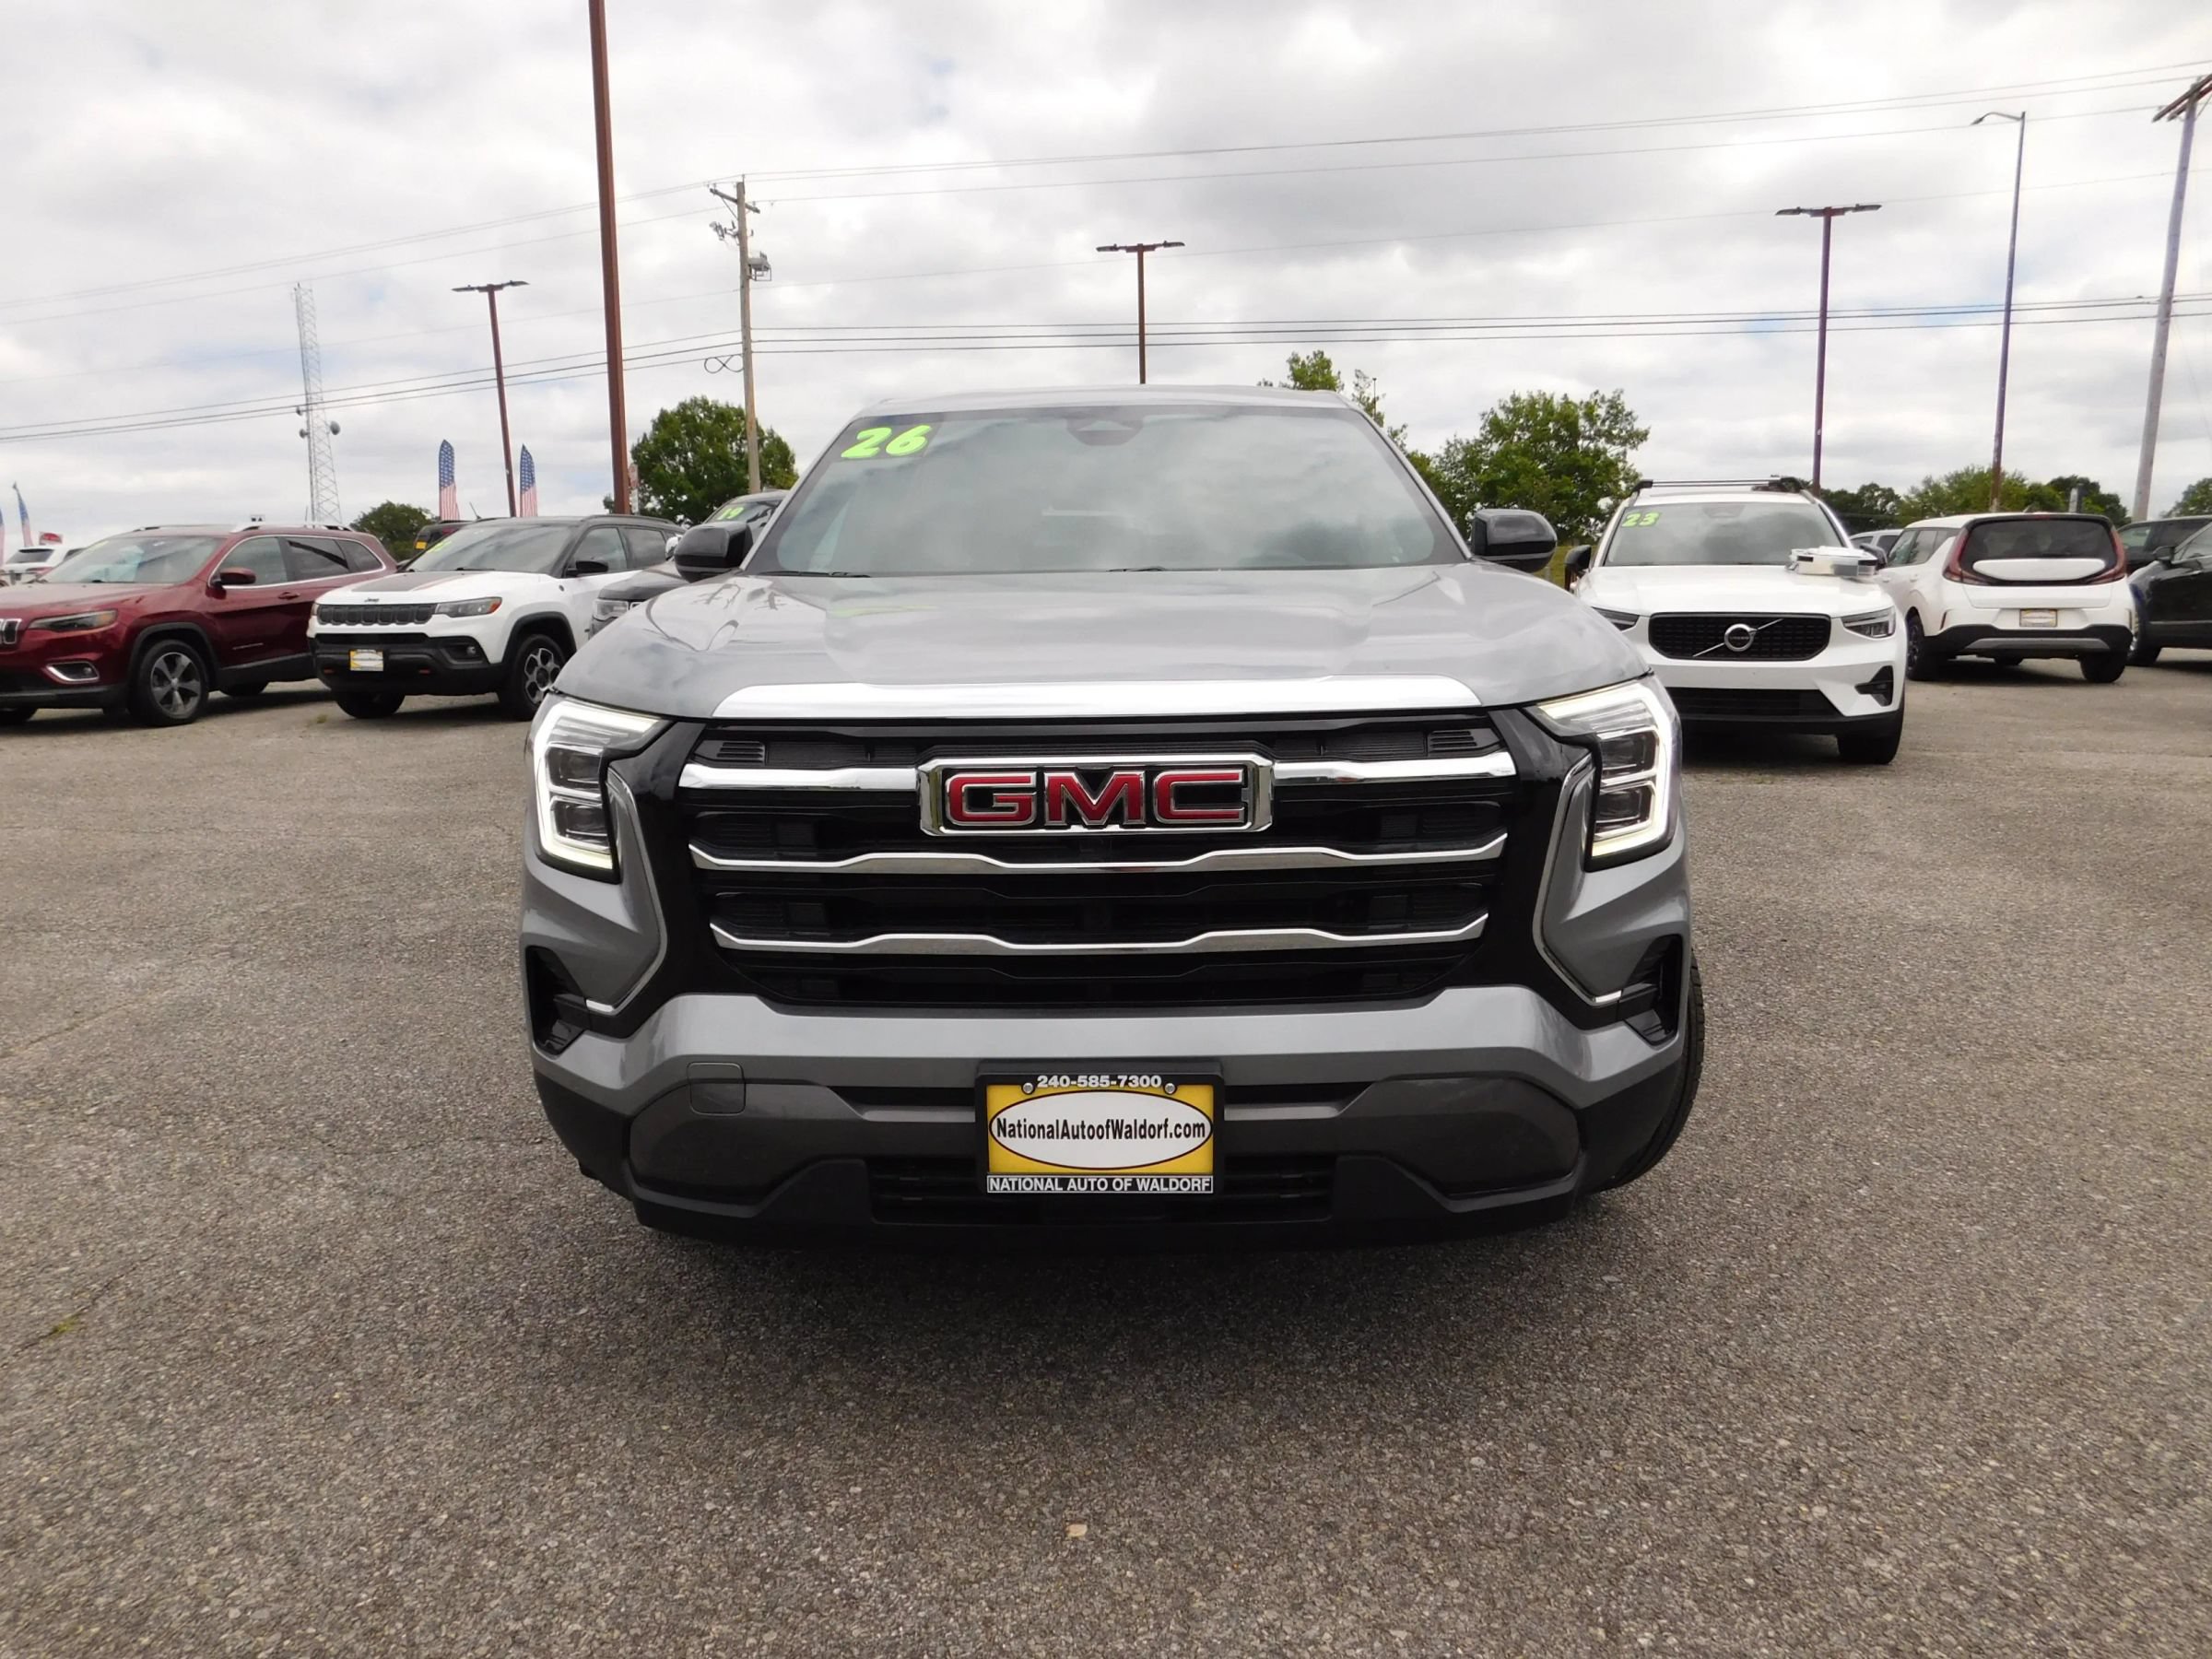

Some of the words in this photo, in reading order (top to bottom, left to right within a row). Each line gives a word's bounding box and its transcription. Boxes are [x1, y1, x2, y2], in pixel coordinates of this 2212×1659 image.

[841, 425, 931, 459] 26
[1622, 511, 1660, 527] 23
[946, 770, 1245, 826] GMC
[1037, 1075, 1162, 1088] 240-585-7300
[996, 1118, 1206, 1139] NationalAutoofWaldorf.com
[989, 1177, 1063, 1192] NATIONAL
[1067, 1177, 1109, 1192] AUTO
[1112, 1177, 1132, 1192] OF
[1135, 1177, 1210, 1192] WALDORF
